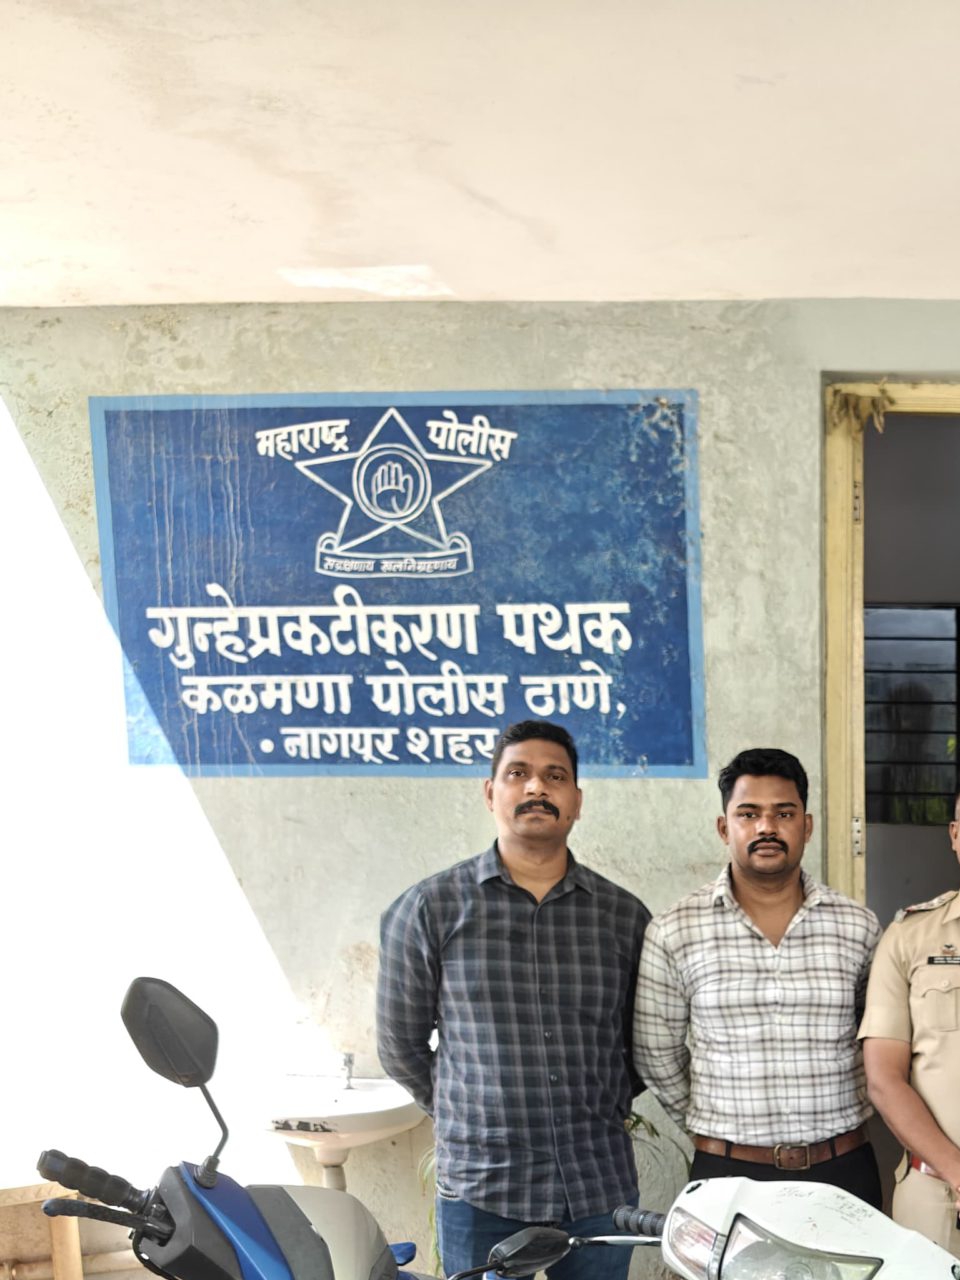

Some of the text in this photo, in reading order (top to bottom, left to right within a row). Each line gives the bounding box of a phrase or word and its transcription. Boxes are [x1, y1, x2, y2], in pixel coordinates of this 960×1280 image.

[256, 409, 518, 461] महाराष्ट्र पोलीस
[496, 602, 632, 655] पथक
[181, 674, 353, 716] कळमणा
[365, 660, 506, 717] पोलीस
[280, 726, 498, 764] नागपूर शहर
